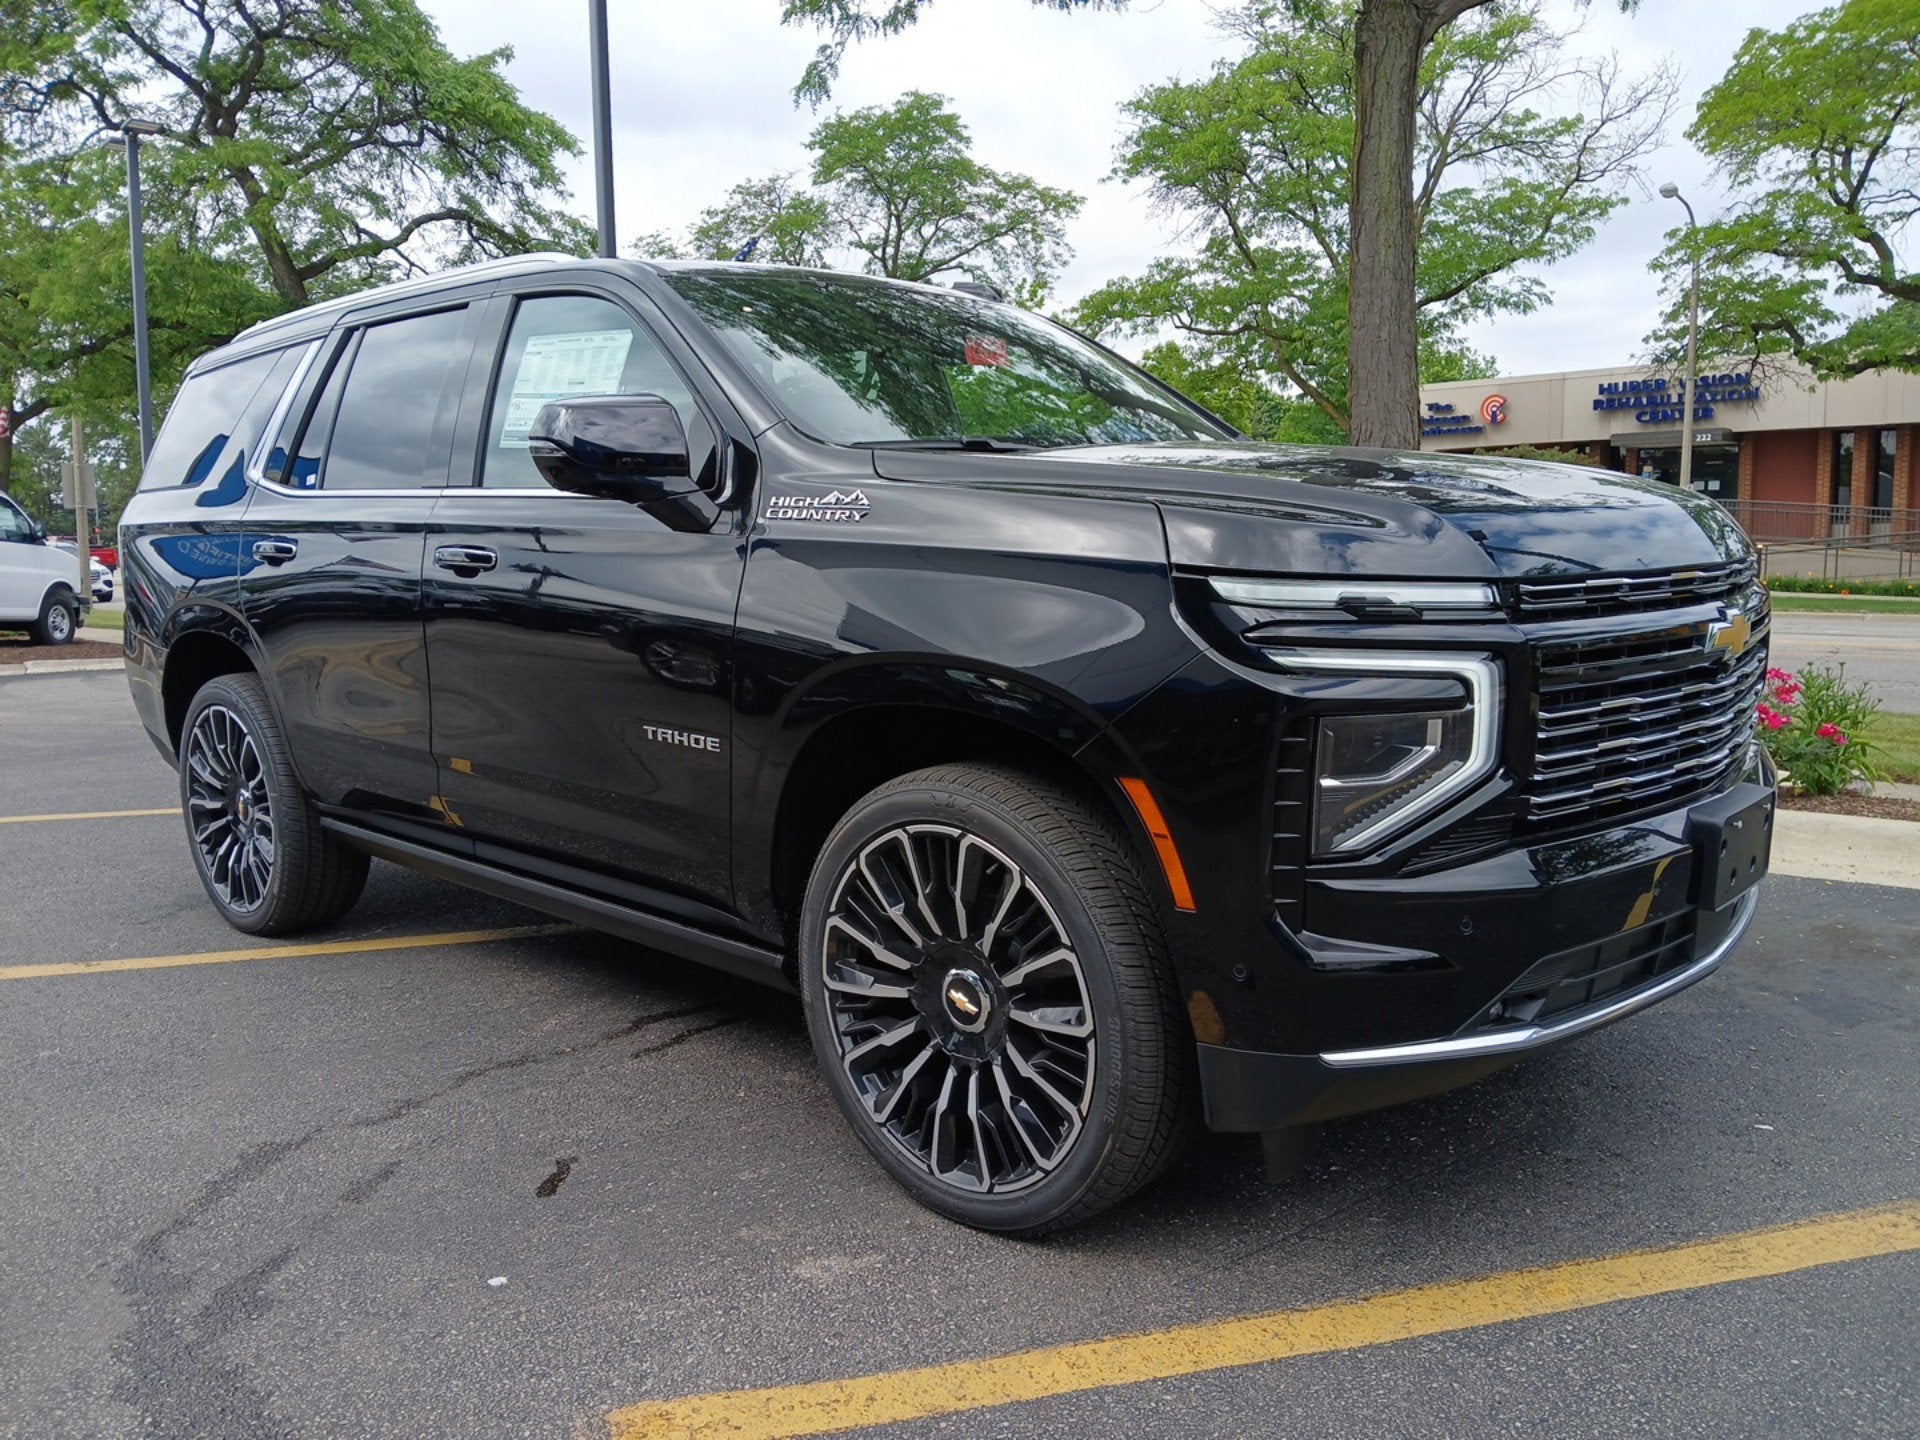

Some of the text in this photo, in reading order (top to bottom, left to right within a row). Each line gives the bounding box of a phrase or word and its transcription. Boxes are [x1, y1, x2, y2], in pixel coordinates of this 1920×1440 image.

[1598, 378, 1667, 395] HUBER
[1592, 386, 1760, 411] REHABILIATION
[1696, 433, 1712, 441] 222
[769, 496, 820, 508] HIGH
[765, 508, 870, 521] COUNTRY
[642, 725, 720, 752] TAHOE
[1104, 1015, 1121, 1126] BRIDGESTONE
